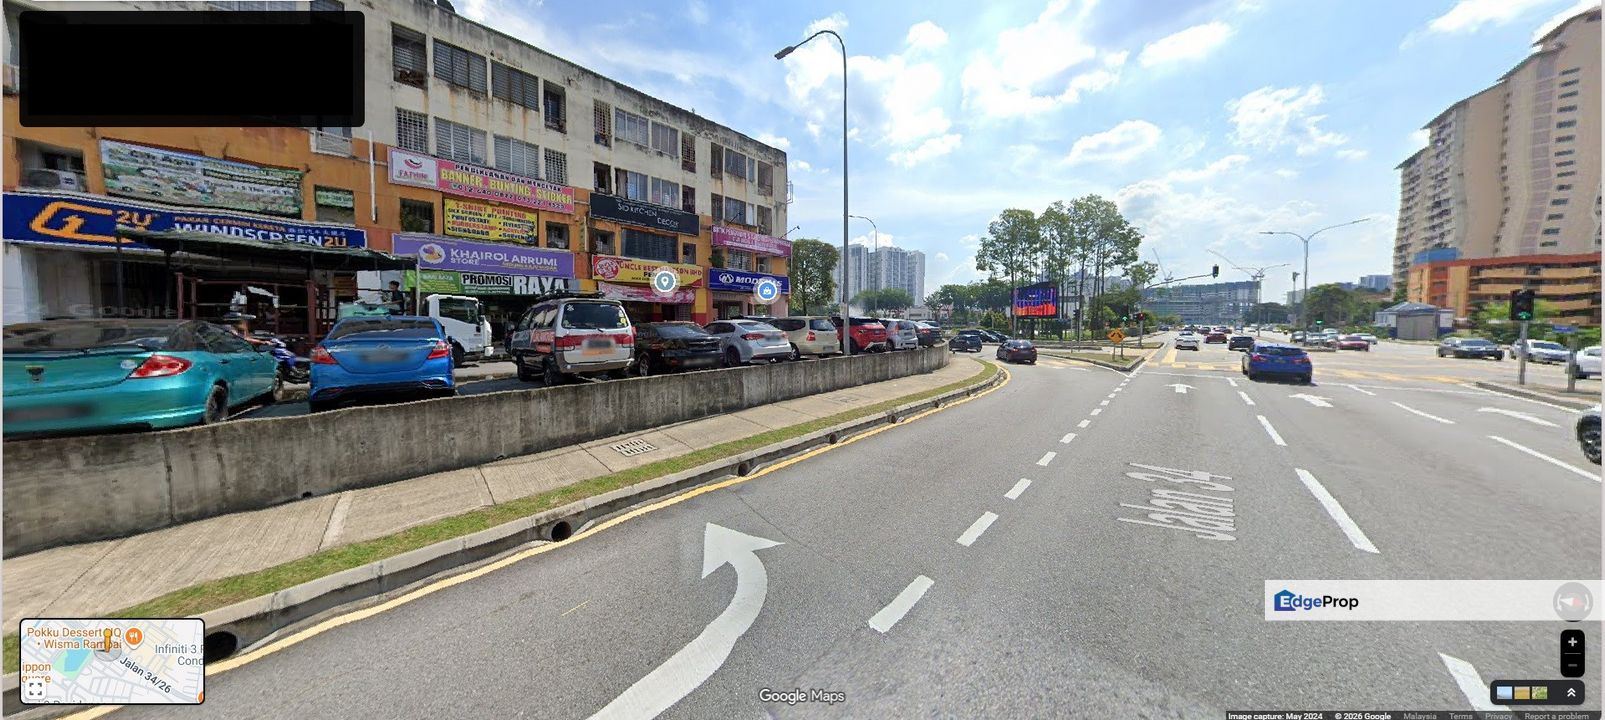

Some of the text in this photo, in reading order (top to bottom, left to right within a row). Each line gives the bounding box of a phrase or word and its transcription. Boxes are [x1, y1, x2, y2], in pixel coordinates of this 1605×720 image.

[450, 248, 510, 261] KHAIROL
[511, 254, 558, 267] ARRUMI
[450, 257, 480, 266] STORE
[462, 274, 513, 286] PROMOSI
[514, 275, 566, 295] RAYA
[1117, 489, 1237, 541] Jalan
